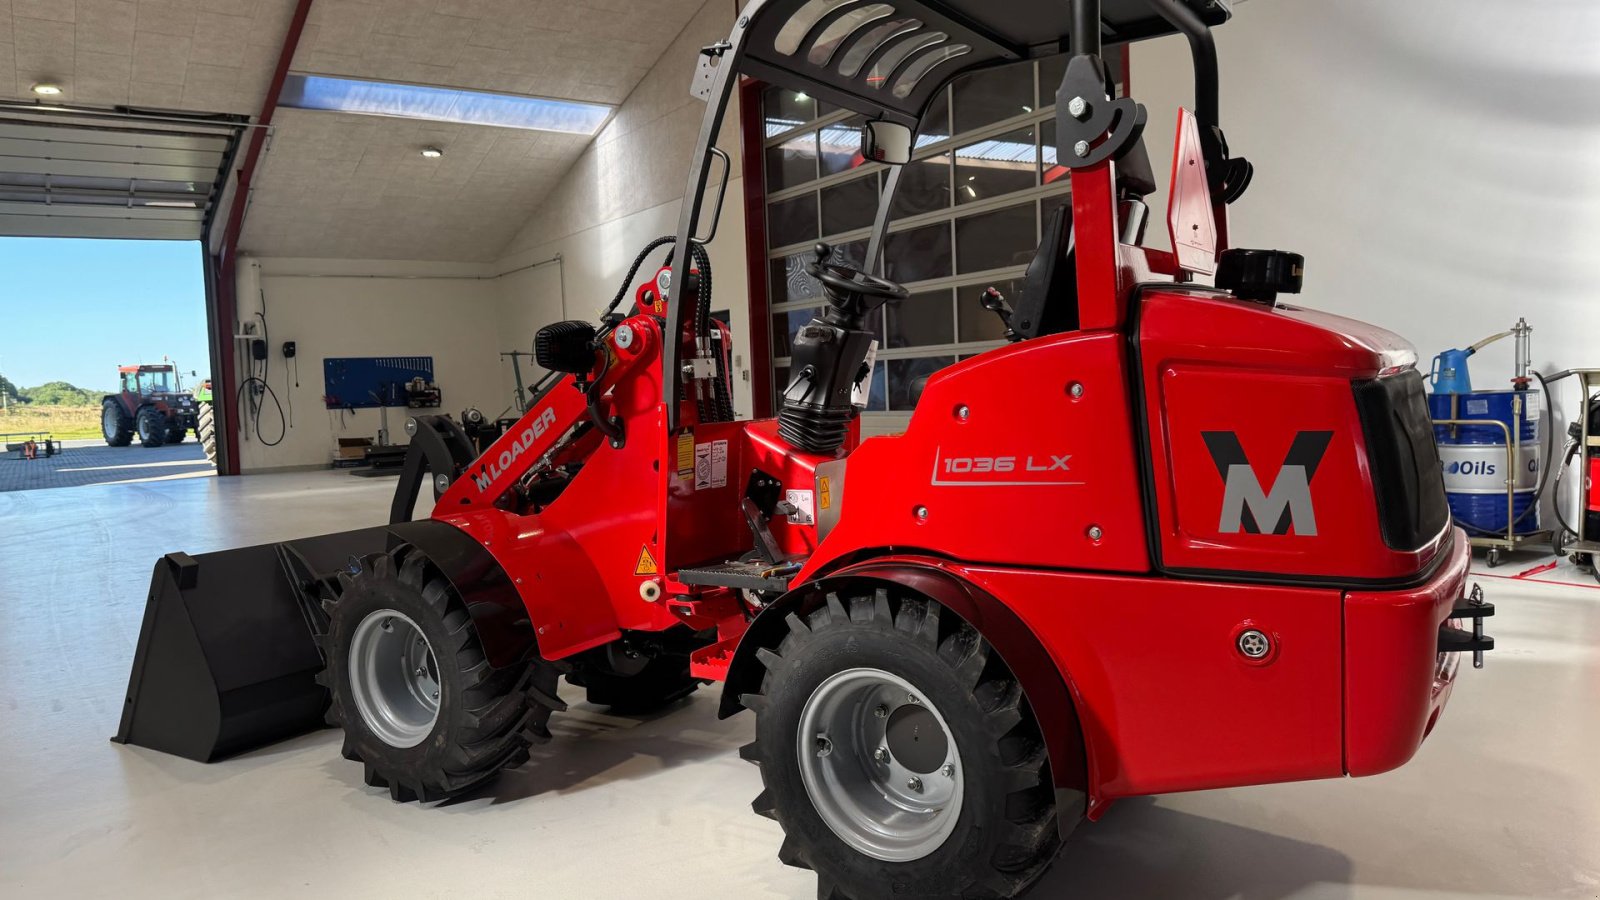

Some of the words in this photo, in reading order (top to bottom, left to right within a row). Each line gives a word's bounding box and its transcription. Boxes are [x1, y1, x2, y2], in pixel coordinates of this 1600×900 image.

[944, 456, 1016, 473] 1036
[1025, 454, 1072, 471] LX
[1460, 460, 1496, 475] Oils
